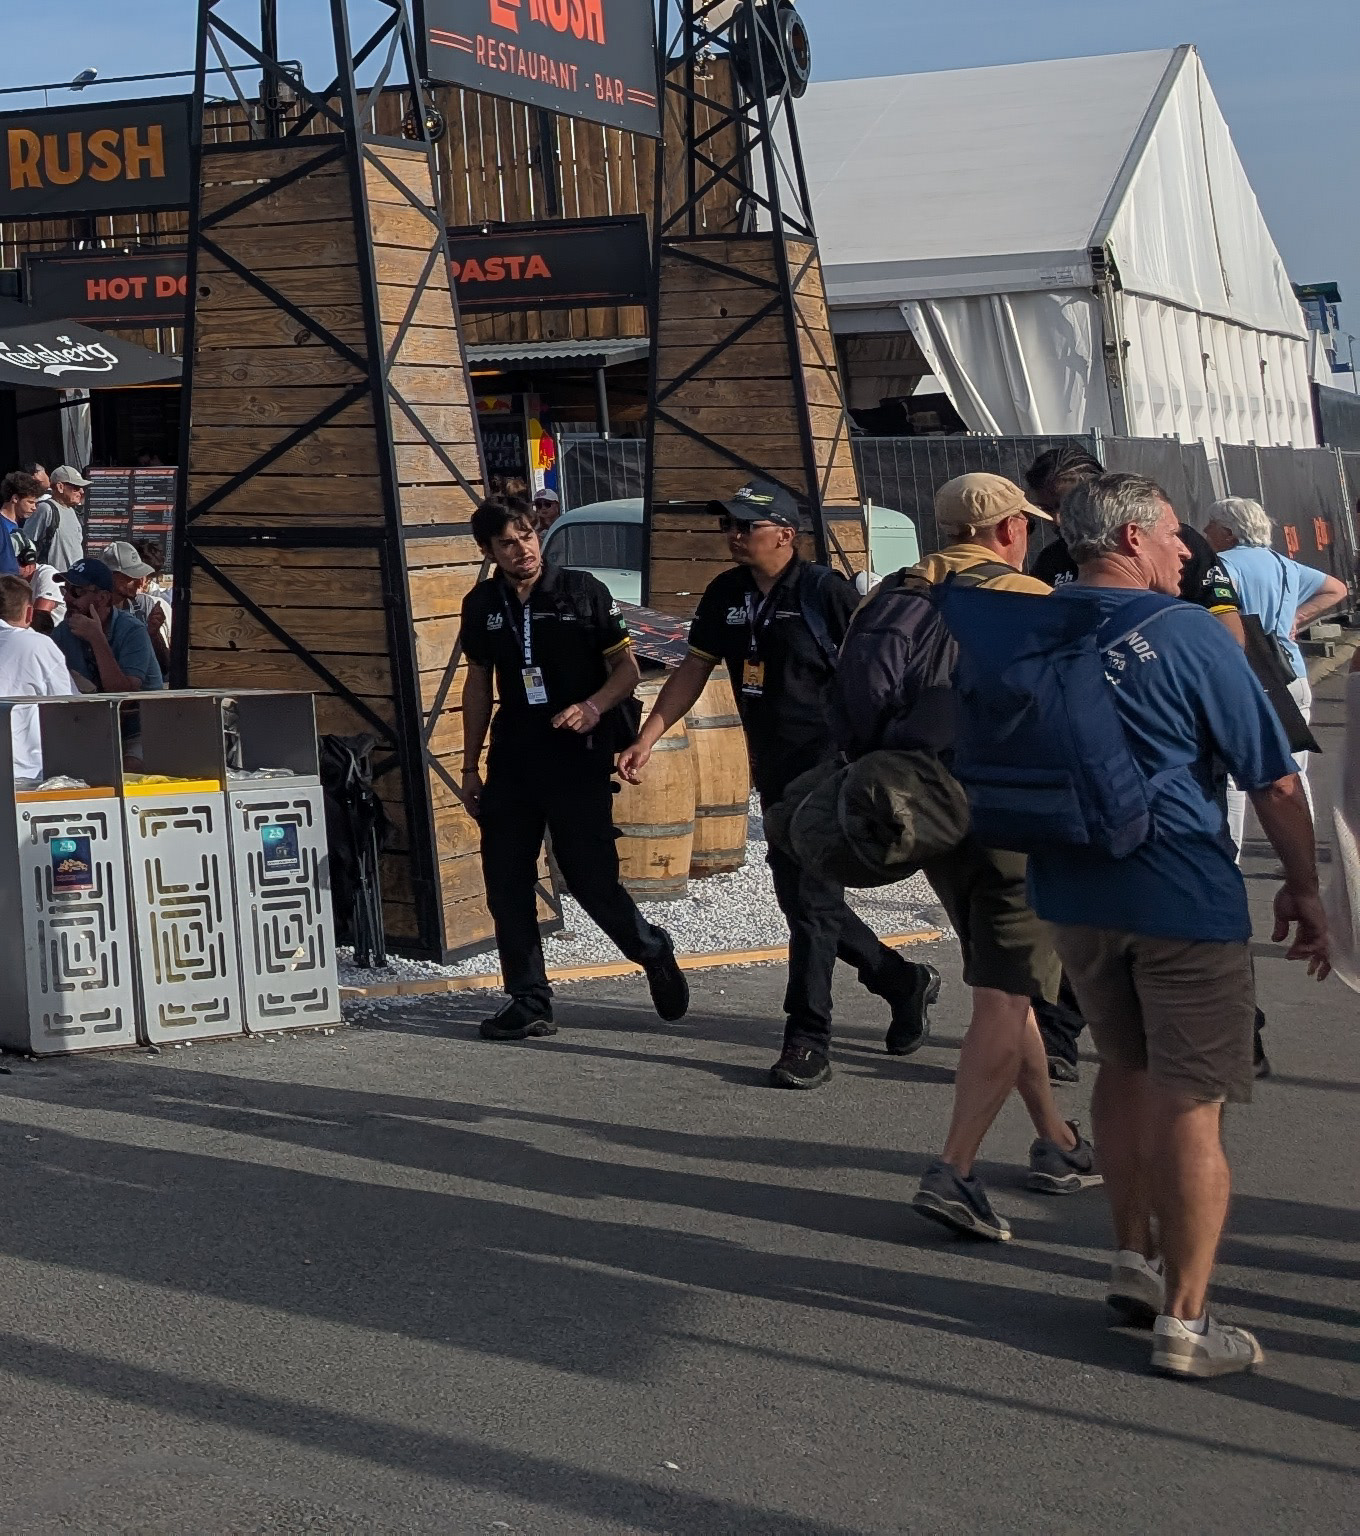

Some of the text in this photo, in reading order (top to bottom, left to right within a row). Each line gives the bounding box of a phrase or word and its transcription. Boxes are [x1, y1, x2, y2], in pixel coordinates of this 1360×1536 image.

[476, 35, 578, 93] RESTAURANT
[594, 74, 625, 105] BAR
[7, 125, 166, 191] RUSH
[86, 276, 148, 301] HOT
[1126, 631, 1158, 663] NDE
